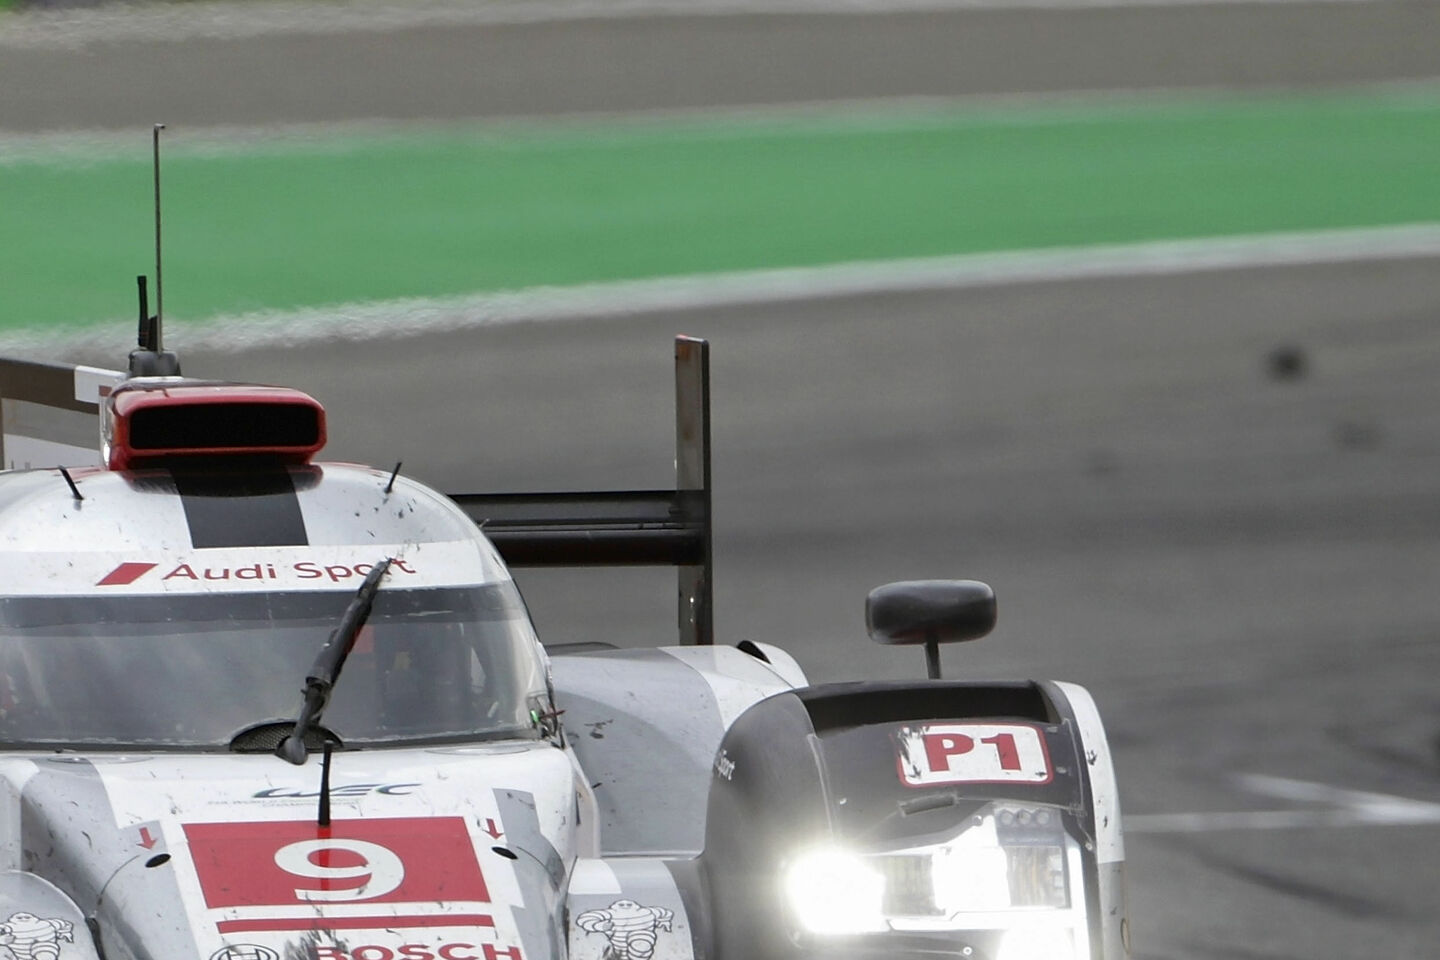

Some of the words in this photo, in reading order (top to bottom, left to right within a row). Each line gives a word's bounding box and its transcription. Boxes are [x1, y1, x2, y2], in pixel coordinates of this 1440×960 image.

[163, 563, 277, 580] Audi
[294, 558, 417, 582] Spot
[923, 733, 1022, 772] P1
[274, 838, 405, 901] 9
